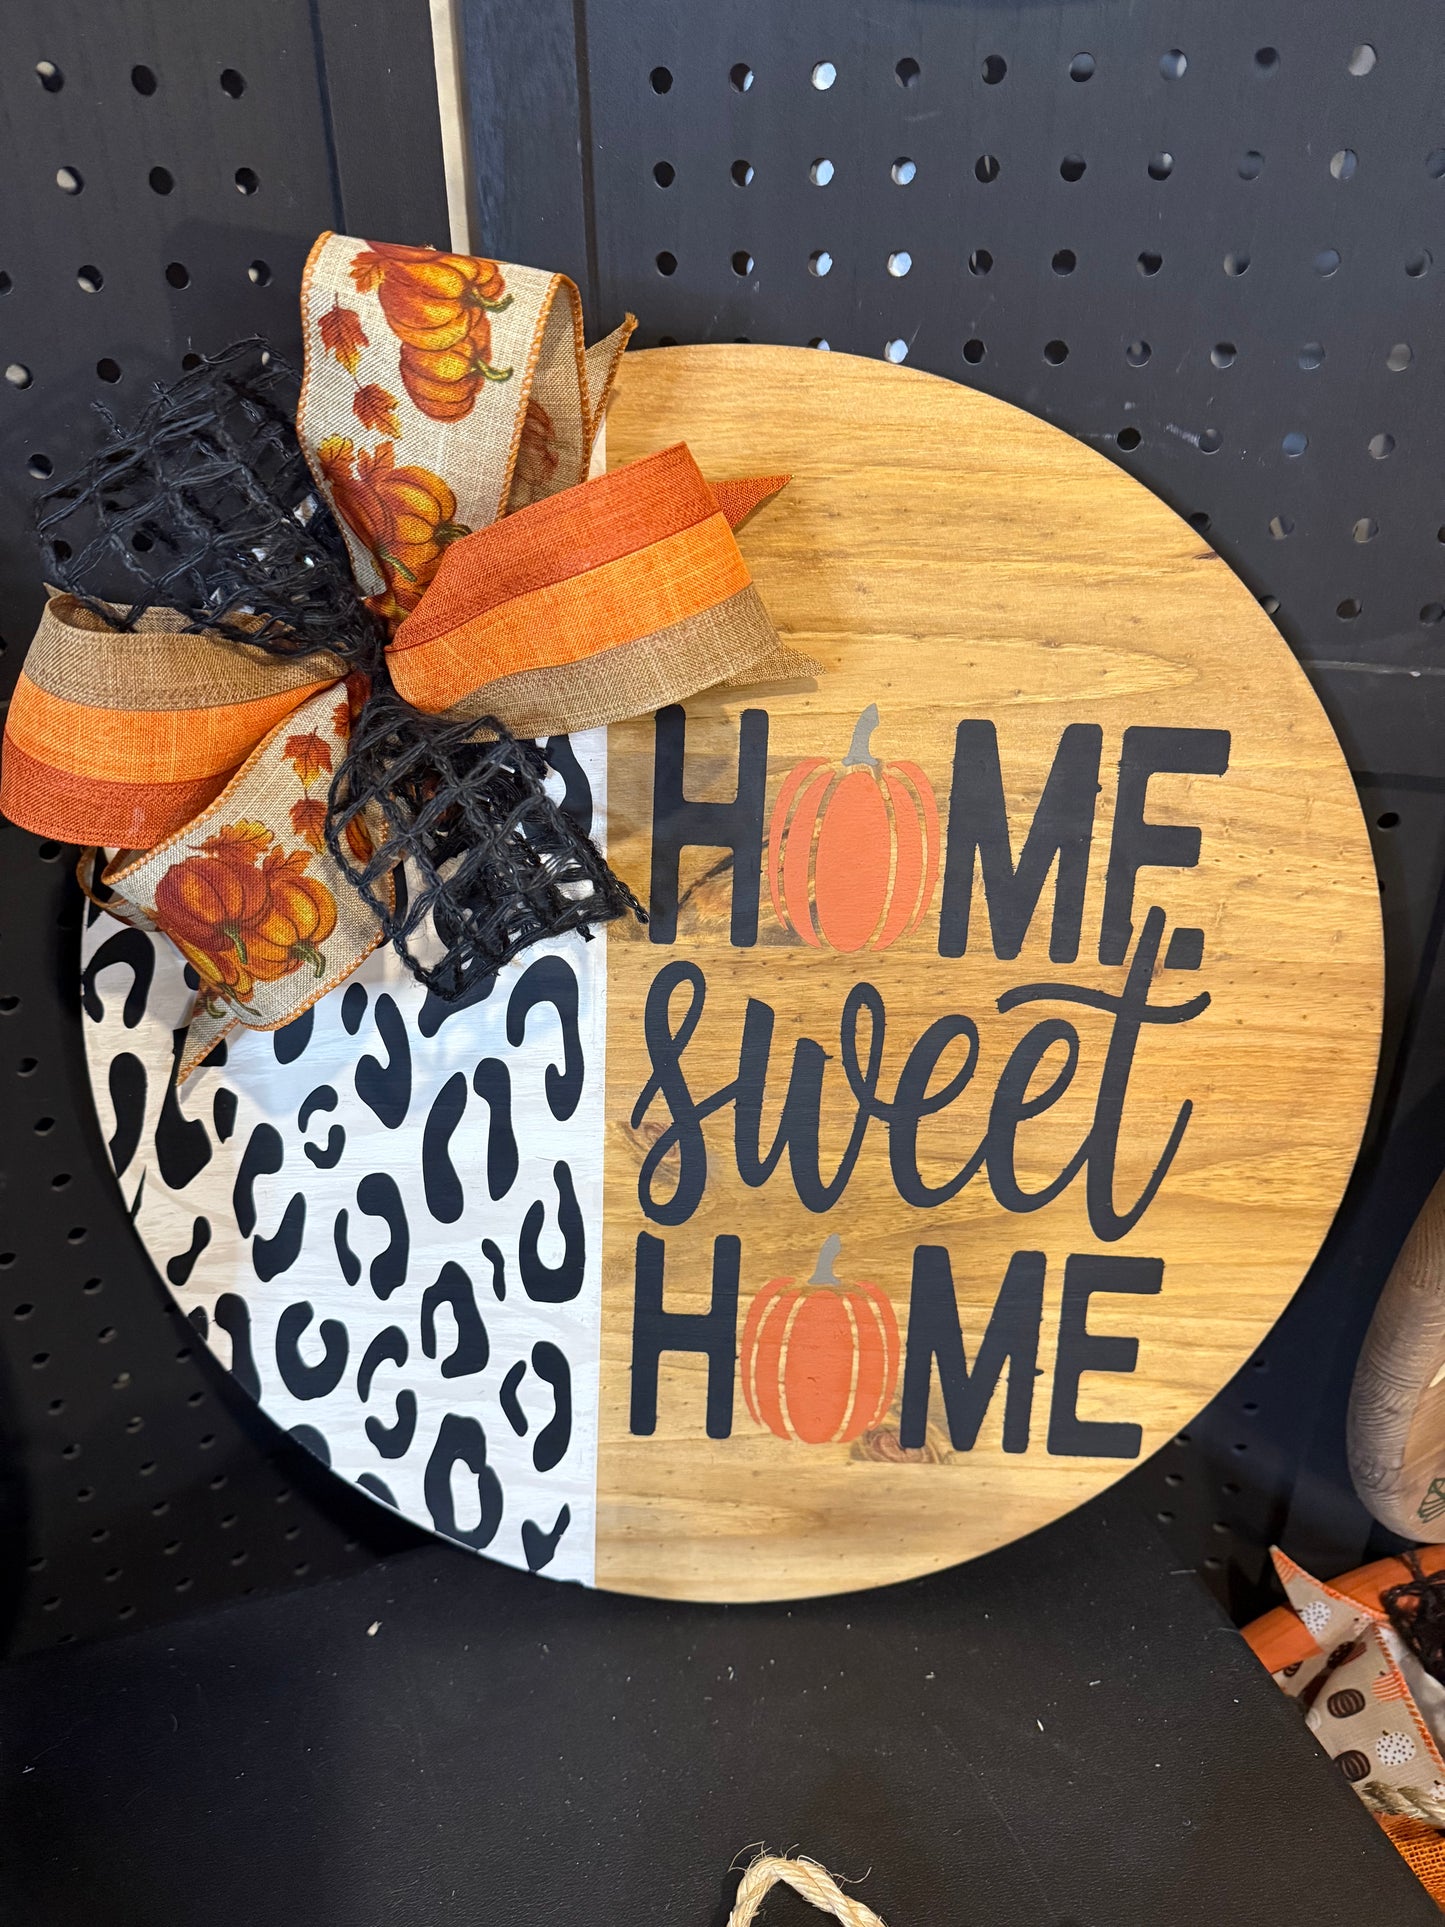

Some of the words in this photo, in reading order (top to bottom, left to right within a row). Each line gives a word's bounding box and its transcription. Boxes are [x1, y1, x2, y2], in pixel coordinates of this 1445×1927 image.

[649, 703, 1231, 970] HOME
[631, 906, 1210, 1242] sweet
[629, 1231, 1165, 1459] HOME
